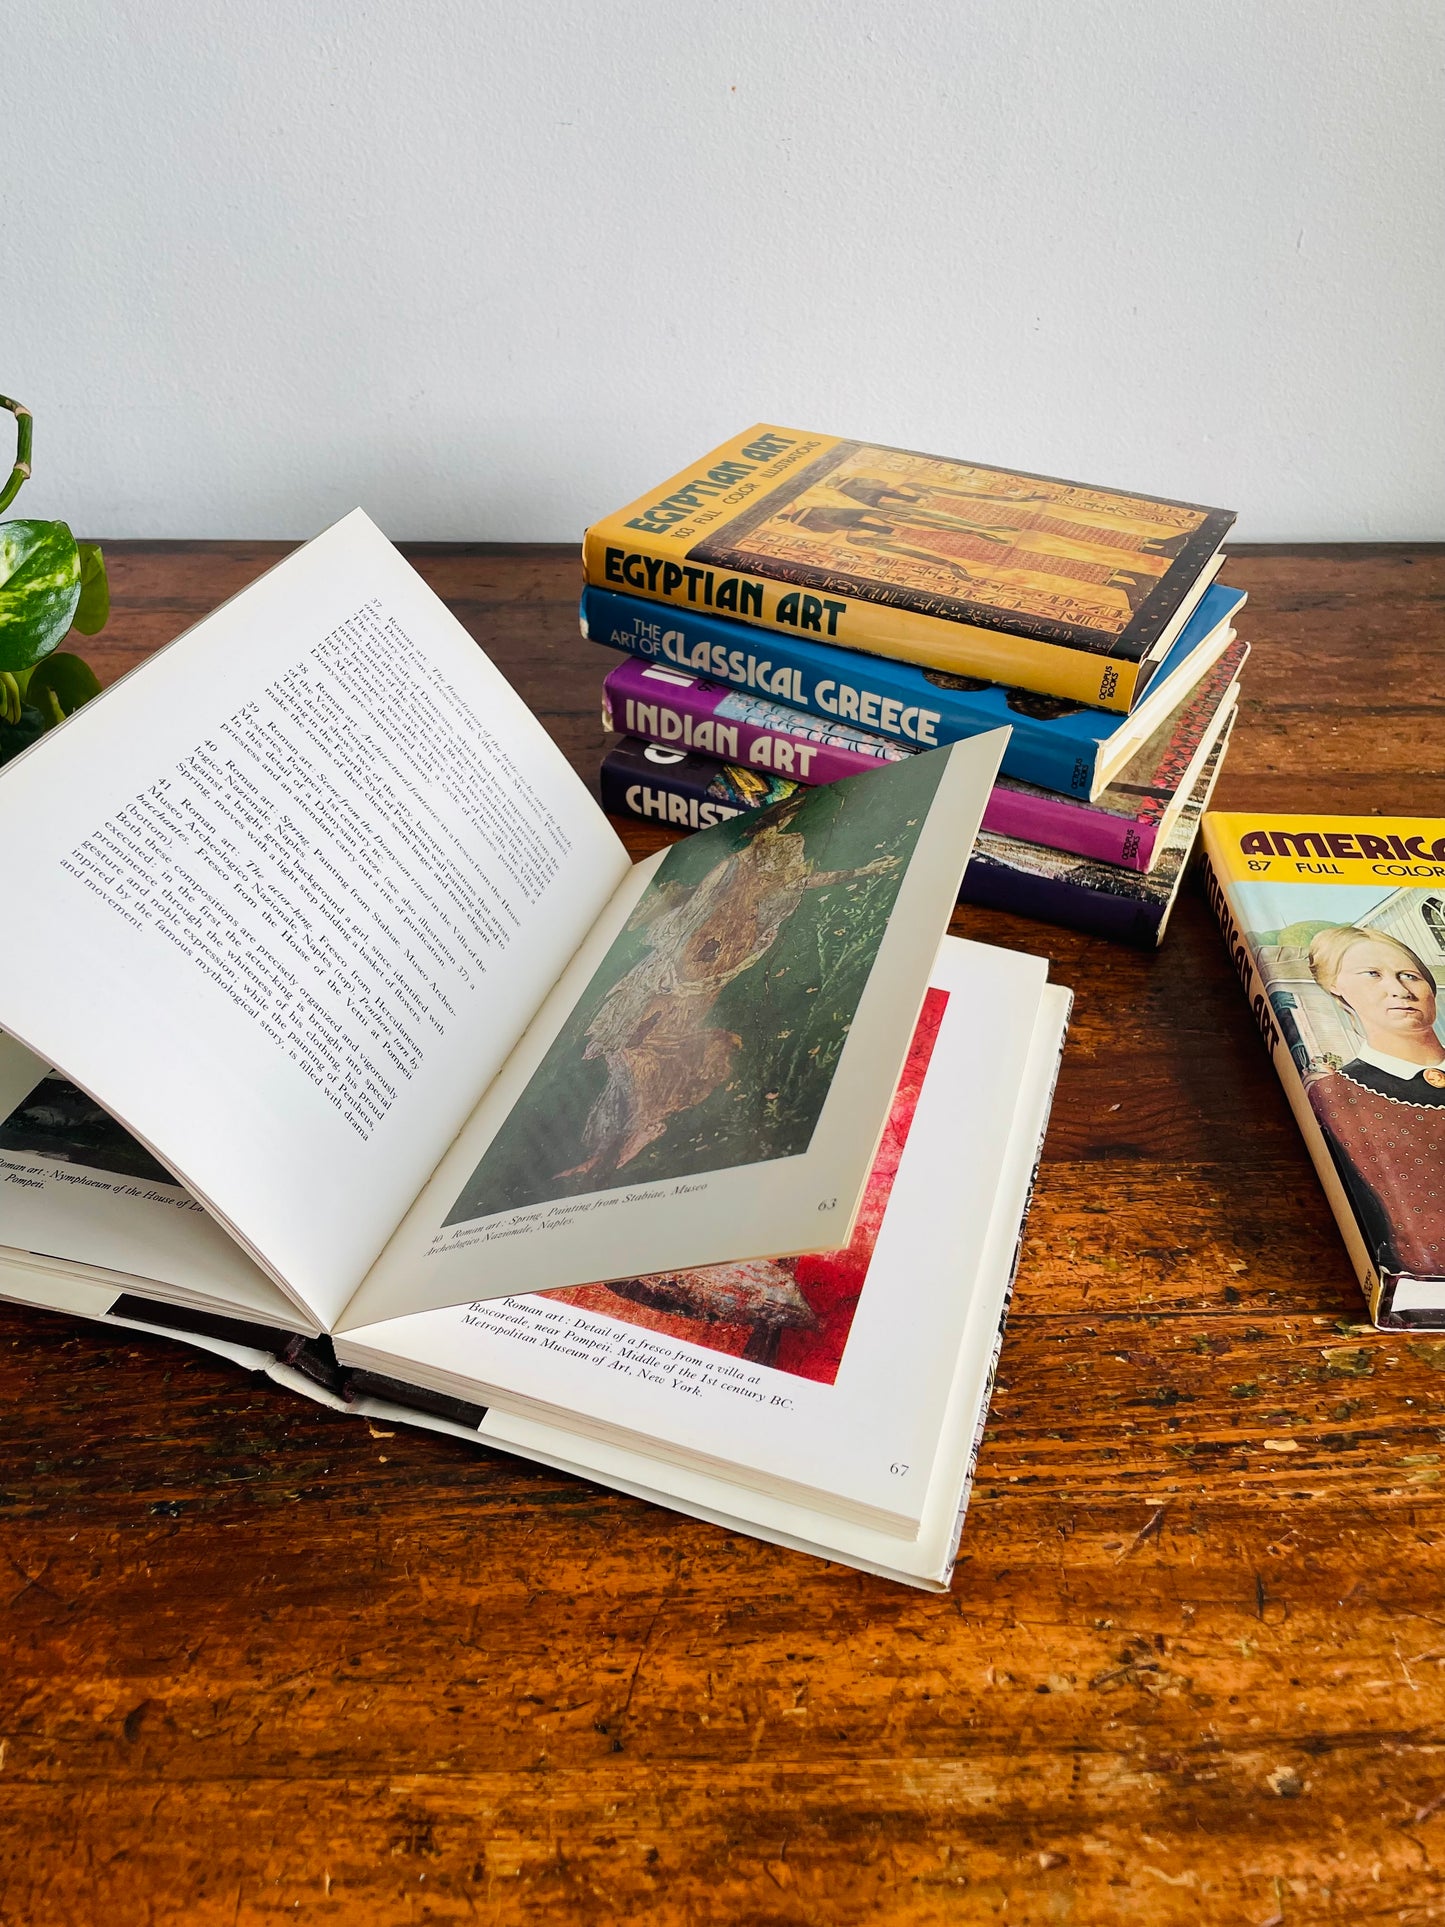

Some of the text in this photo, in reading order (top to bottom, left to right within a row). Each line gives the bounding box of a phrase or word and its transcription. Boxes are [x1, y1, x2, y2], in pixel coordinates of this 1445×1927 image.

[624, 433, 797, 534] EGYPTIAN ART
[670, 441, 823, 540] 103 FULL COLOR ILLUSTRATIONS
[605, 547, 846, 636] EGYPTIAN ART
[632, 618, 661, 640] THE
[610, 629, 662, 656] ART OF
[661, 630, 942, 746] CLASSICAL GREECE
[1099, 665, 1113, 700] OCTOPUS
[1108, 672, 1119, 698] BOOKS
[625, 699, 738, 758] INDIAN
[749, 735, 817, 777] ART
[1071, 757, 1082, 790] OCTOPUS
[125, 803, 175, 849] (bottom).
[1122, 829, 1134, 860] OCTOPUS
[1130, 836, 1140, 858] BOOKS
[59, 859, 143, 932] and movement.
[1248, 860, 1445, 877] 87 FULL COLOR
[114, 811, 398, 1100] Both these compositions are precisely organized and vigorously
[135, 793, 415, 1080] bacchantes. Fresco from the House of the Vettii at Pompeii
[147, 785, 420, 1070] Museo Archeologico Nazionale, Naples (top). Pentheus torn by
[158, 778, 172, 791] 41
[179, 798, 217, 834] Roman
[245, 859, 265, 880] The
[267, 884, 313, 933] actor-king.
[318, 934, 348, 969] Fresco
[350, 969, 372, 996] from
[374, 996, 424, 1061] Herculaneum.
[1200, 852, 1280, 1054] AMERICAN ART
[71, 847, 370, 1142] inpired by the famous mythological story, is filled with drama
[80, 837, 126, 877] gesture
[124, 874, 151, 897] and
[149, 896, 183, 927] noble
[241, 983, 269, 1012] while
[271, 1012, 289, 1031] the
[287, 1030, 328, 1073] painting
[325, 1068, 339, 1084] of
[336, 1081, 377, 1132] Pentheus,
[91, 829, 386, 1121] prominence through the whiteness of his clothing, his proud
[160, 869, 175, 884] in
[177, 883, 197, 904] the
[198, 905, 223, 928] first
[225, 927, 245, 948] the
[245, 950, 294, 1001] actor-king
[296, 1000, 306, 1013] is
[306, 1012, 345, 1055] brought
[345, 1053, 365, 1077] into
[363, 1075, 394, 1112] special
[5, 1173, 47, 1189] Pompeii.
[49, 1169, 112, 1191] Nymphaeum
[113, 1184, 128, 1194] of
[125, 1187, 142, 1197] the
[143, 1190, 175, 1205] House
[176, 1200, 191, 1209] of
[432, 1235, 443, 1244] 40
[451, 1228, 483, 1239] Roman
[547, 1203, 591, 1218] Painting
[591, 1198, 618, 1211] from
[670, 1182, 708, 1196] Museo
[817, 1198, 837, 1211] 63
[423, 1216, 574, 1257] Archeologico Nazionale, Naples.
[461, 1314, 703, 1397] Metropolitan Museum of Art, New York.
[468, 1302, 795, 1411] Boscoreale, near Pompeii. Middle of the 1st century BC.
[502, 1297, 544, 1316] Roman
[573, 1318, 612, 1338] Detail
[613, 1332, 627, 1342] of
[635, 1338, 672, 1357] fresco
[673, 1352, 703, 1367] from
[717, 1366, 744, 1380] villa
[747, 1376, 761, 1385] at
[890, 1462, 909, 1476] 67
